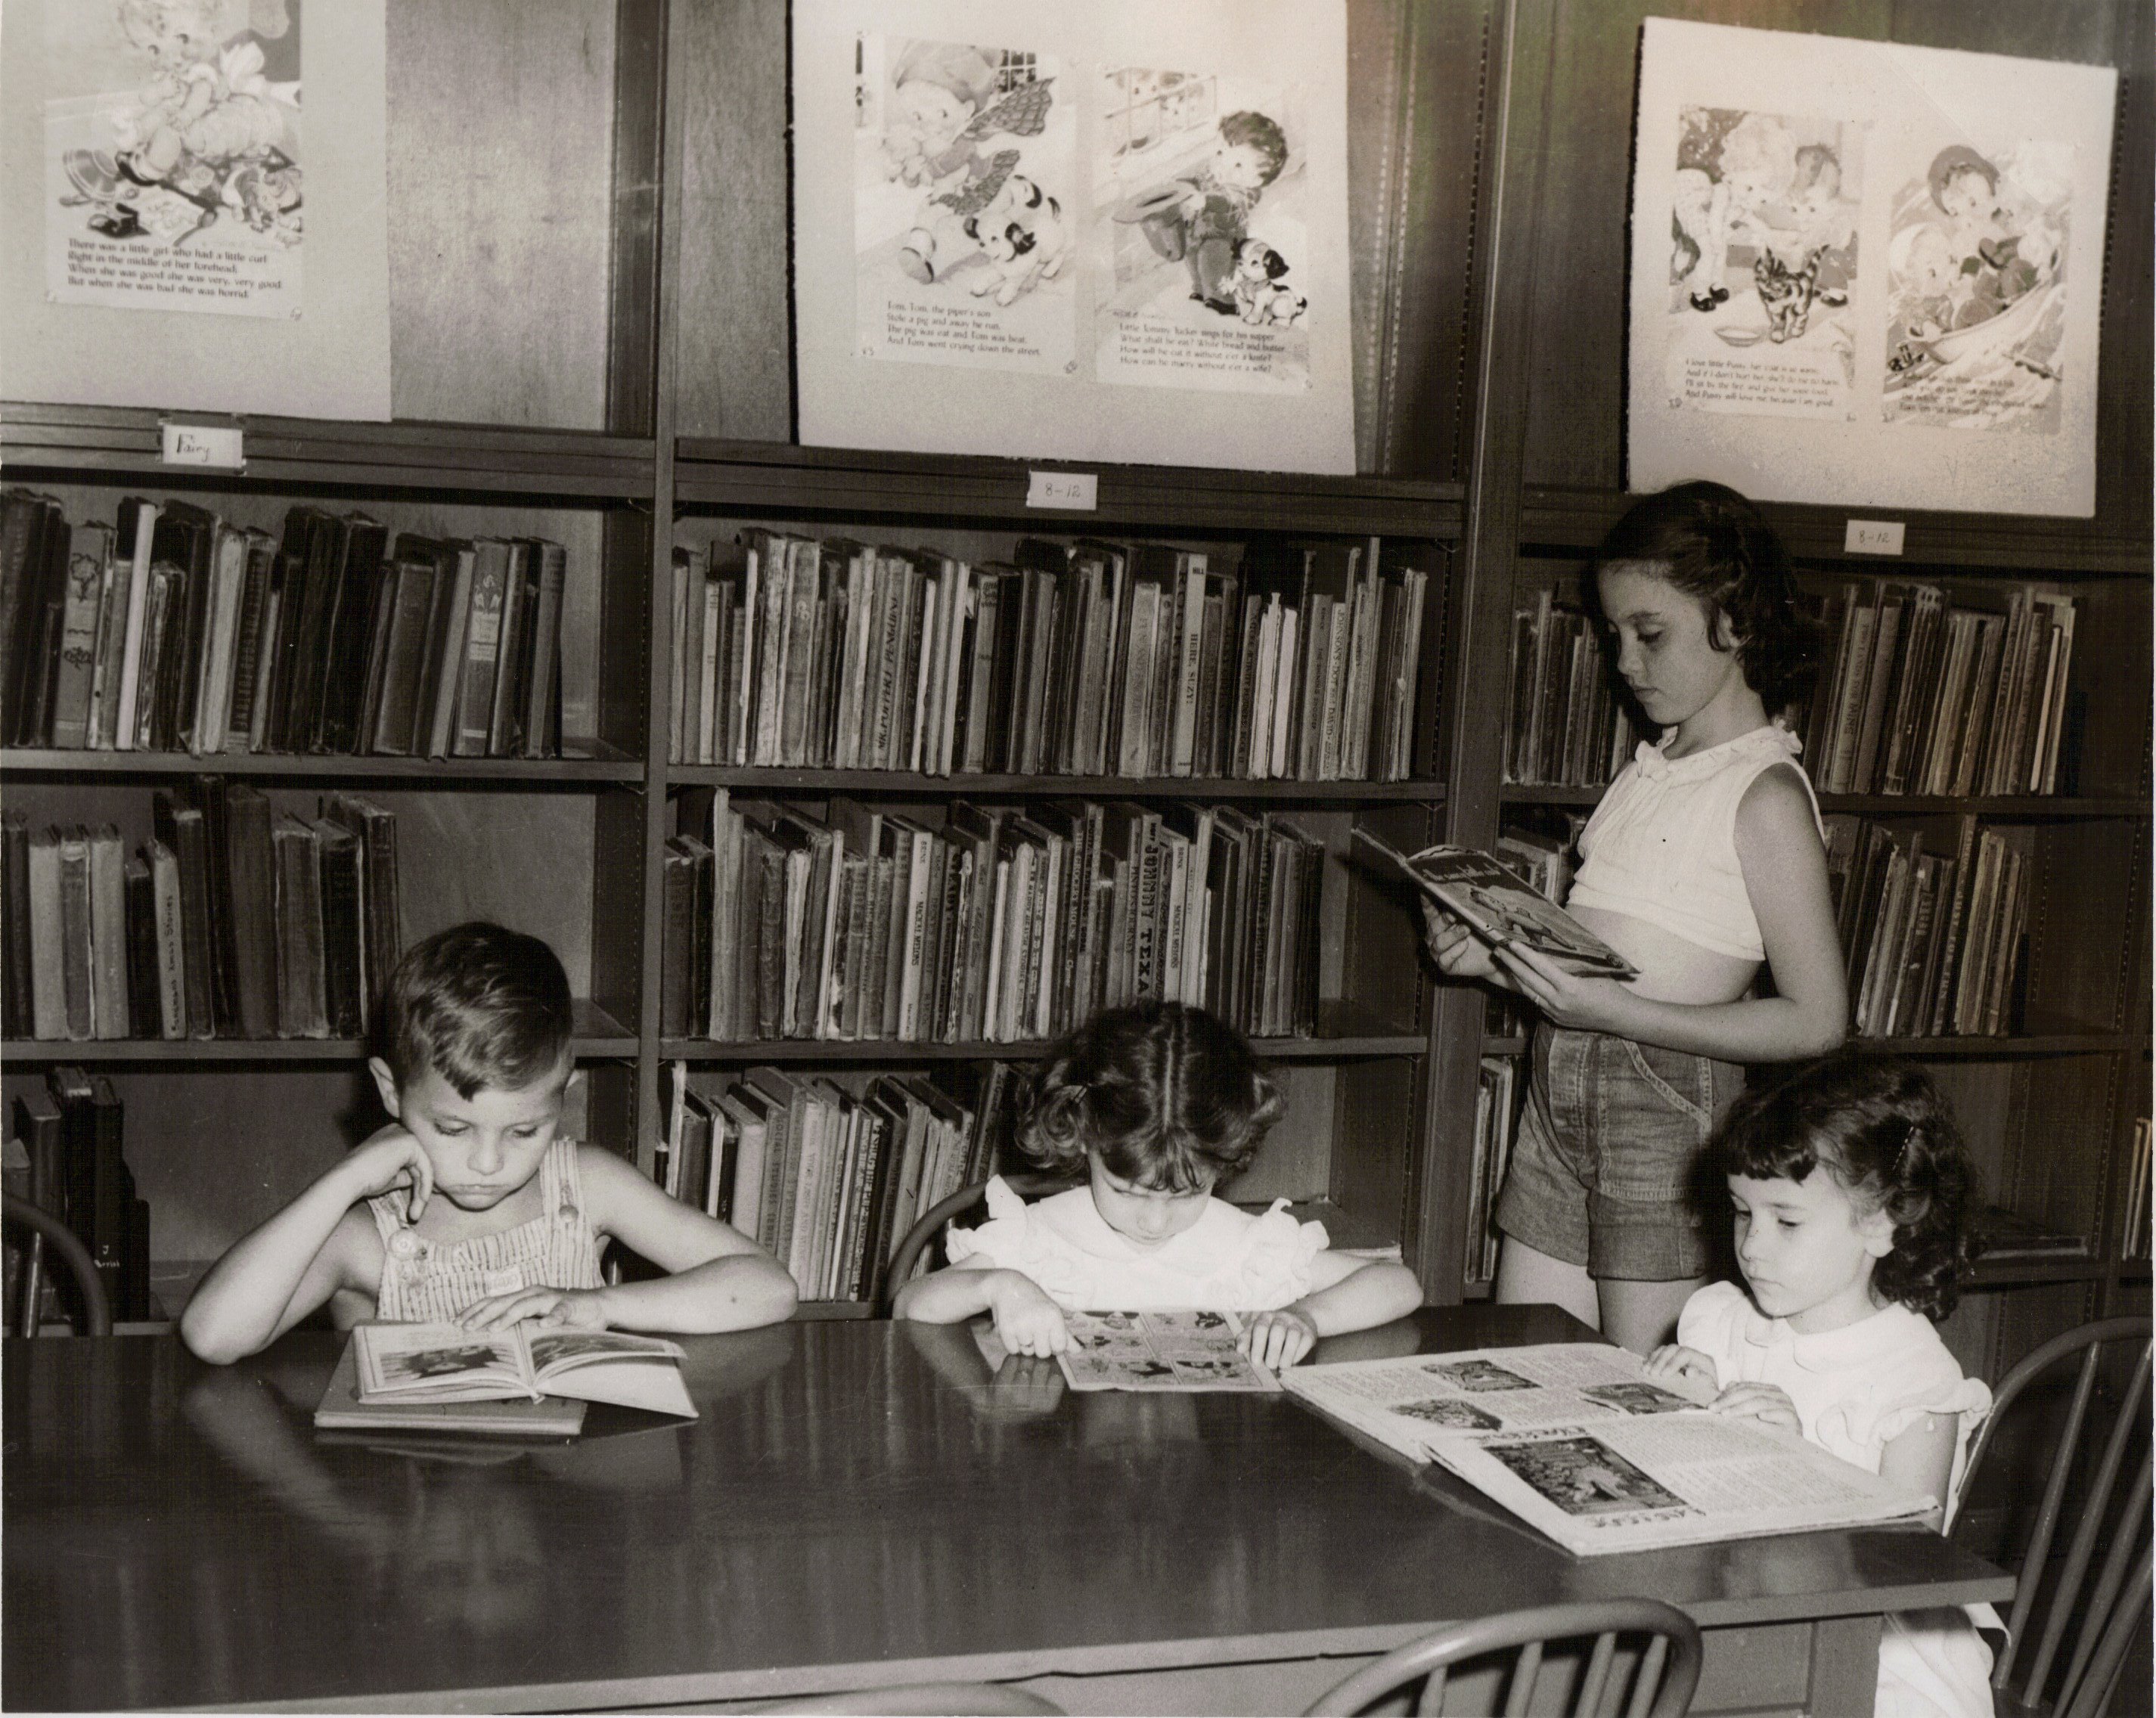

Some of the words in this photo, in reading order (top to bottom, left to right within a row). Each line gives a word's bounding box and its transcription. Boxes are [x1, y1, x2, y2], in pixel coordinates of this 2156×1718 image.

[68, 250, 92, 262] Right
[109, 255, 123, 264] the
[127, 256, 158, 266] middle
[175, 260, 191, 269] her
[70, 238, 95, 249] There
[129, 244, 150, 253] little
[154, 247, 168, 256] girl
[172, 248, 191, 257] who
[195, 249, 212, 259] had
[225, 252, 244, 261] little
[68, 263, 96, 274] When
[100, 266, 115, 275] she
[168, 271, 183, 281] she
[68, 276, 84, 286] But
[88, 278, 113, 287] when
[157, 283, 174, 292] bad
[178, 286, 194, 294] she
[176, 433, 209, 462] Fairy
[1045, 482, 1081, 499] 8-12
[1071, 854, 1082, 903] GROCERY
[1141, 844, 1159, 919] JOHNNY
[1069, 905, 1079, 941] MOUSE
[1137, 928, 1152, 997] TEXA
